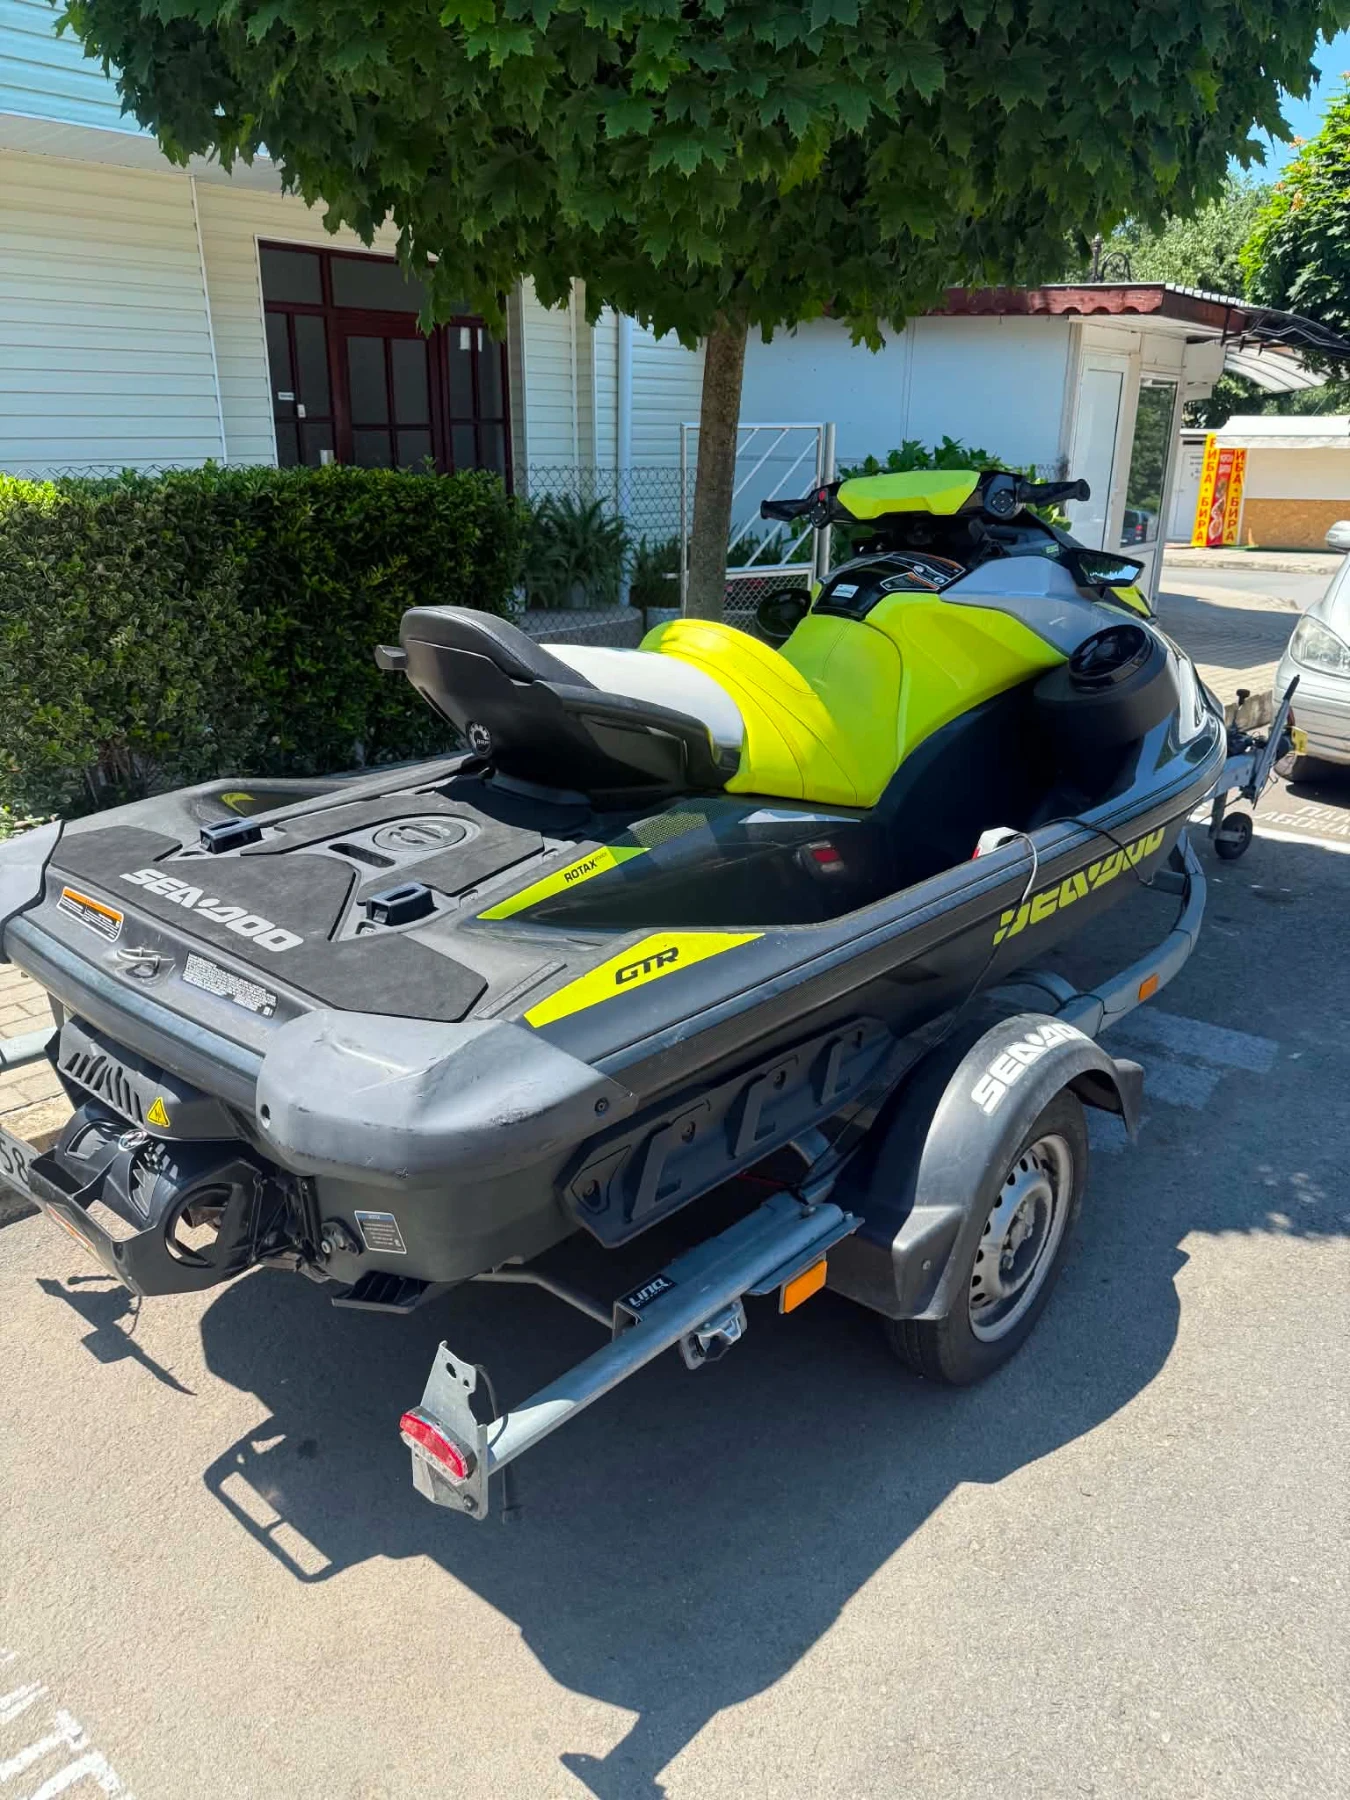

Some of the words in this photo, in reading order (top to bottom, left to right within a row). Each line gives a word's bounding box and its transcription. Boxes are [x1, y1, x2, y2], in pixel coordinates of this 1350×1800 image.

[1233, 449, 1247, 484] ИБА
[1196, 497, 1209, 542] БИРА
[1226, 497, 1240, 542] БИРА
[564, 860, 597, 883] ROTAX
[615, 946, 679, 985] GTR
